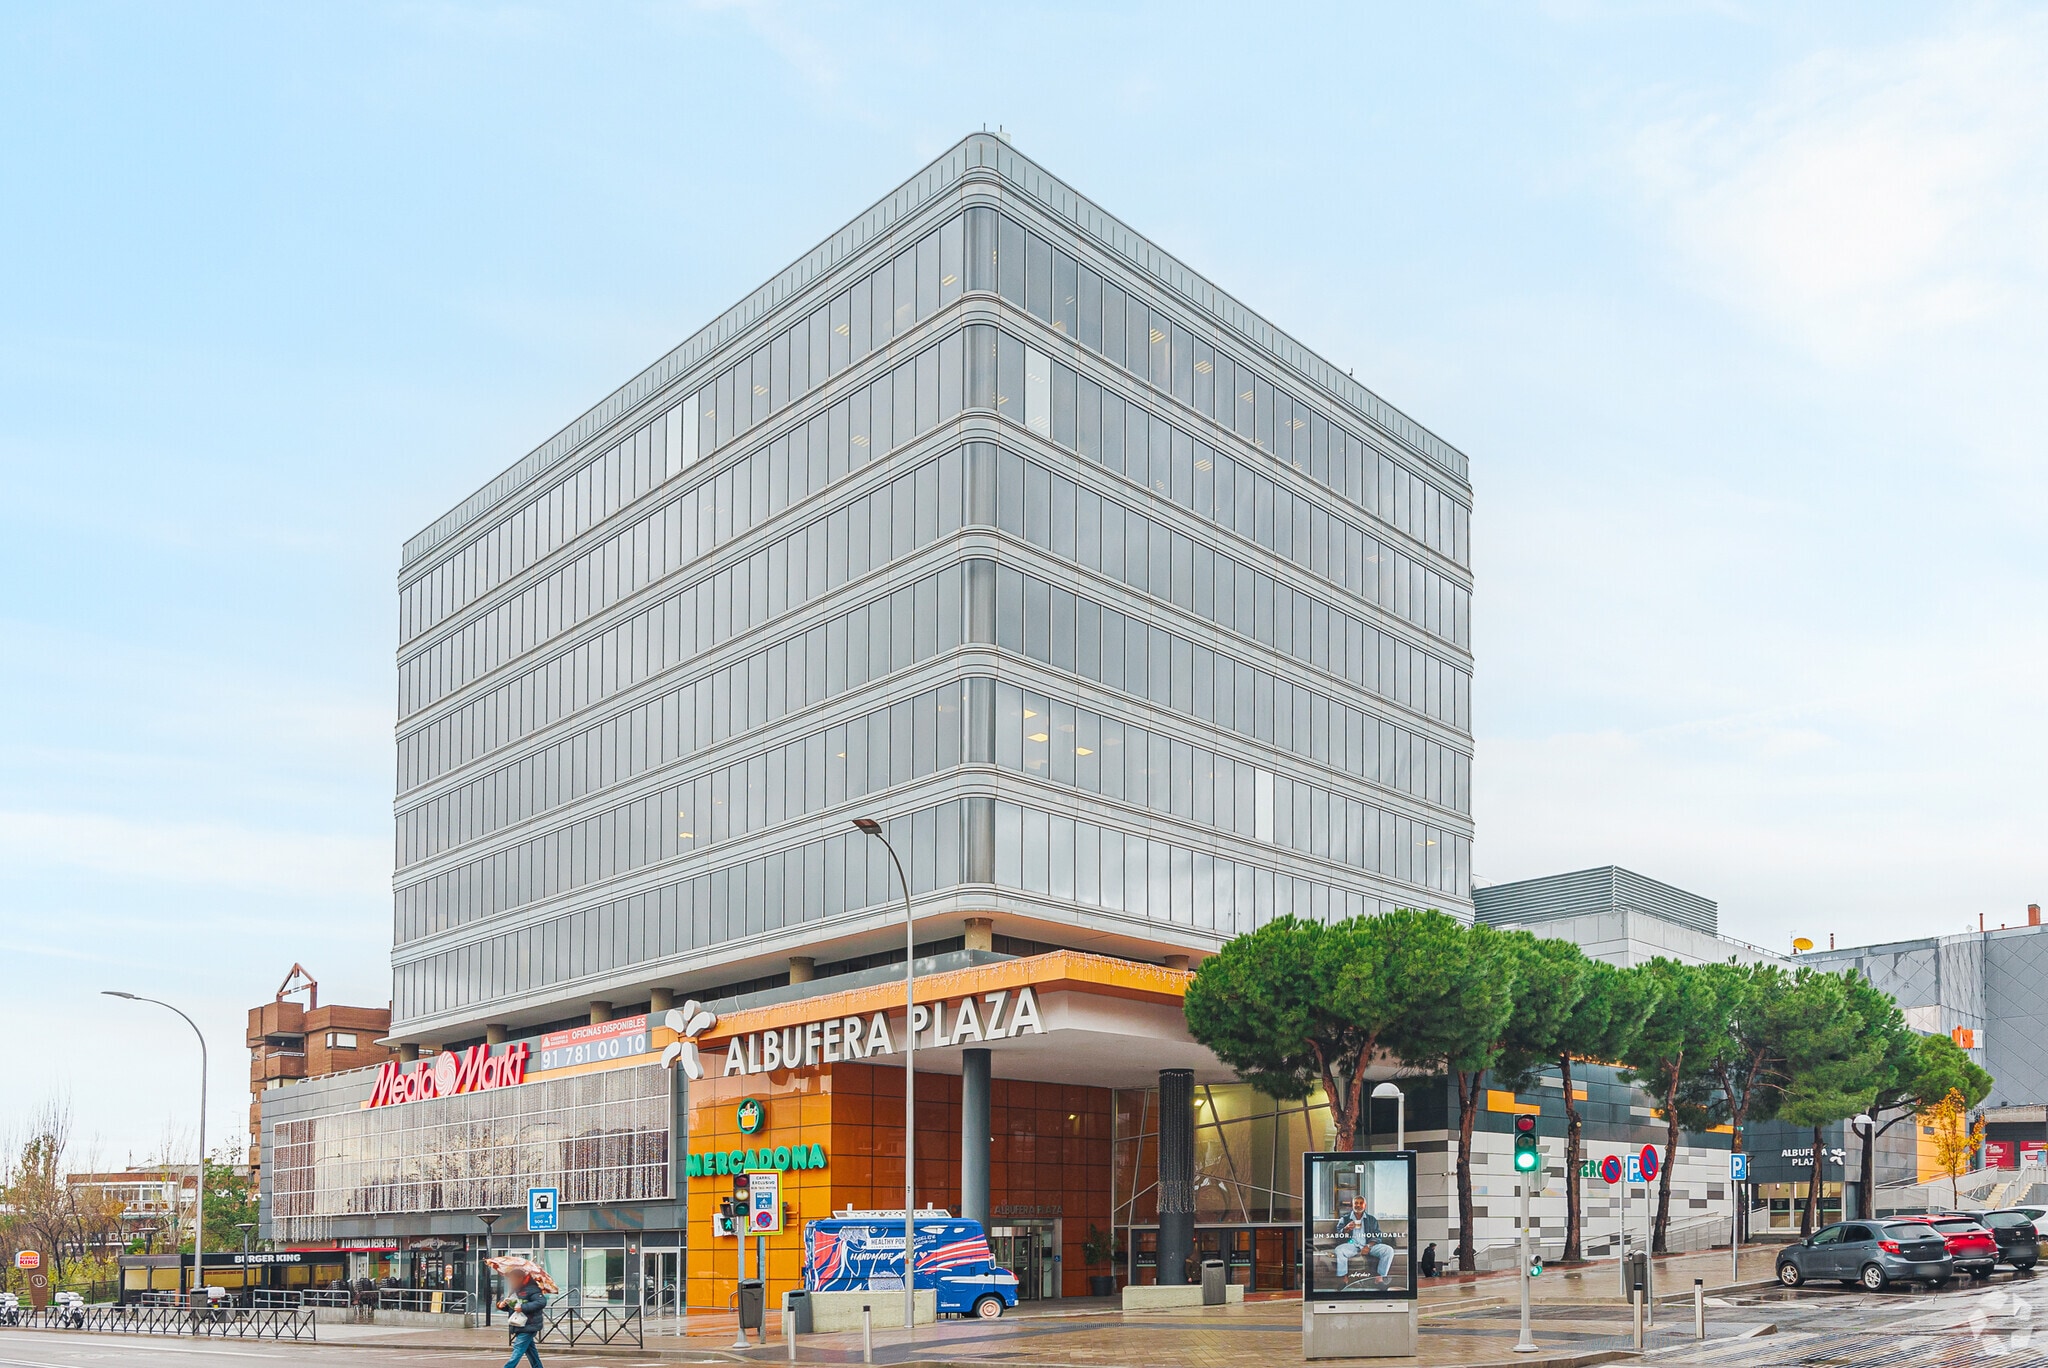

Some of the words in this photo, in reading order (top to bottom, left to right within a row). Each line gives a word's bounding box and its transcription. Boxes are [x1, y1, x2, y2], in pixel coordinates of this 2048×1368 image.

[571, 1026, 601, 1040] OFICINAS
[602, 1018, 646, 1034] DISPONIBLES
[723, 1011, 898, 1077] ALBUFERA
[912, 986, 1048, 1050] PLAZA
[543, 1050, 558, 1069] 91
[565, 1044, 591, 1065] 781
[597, 1039, 619, 1060] 00
[626, 1034, 645, 1055] 10
[368, 1061, 438, 1108] Media
[450, 1042, 531, 1095] Markt
[1781, 1148, 1828, 1157] ALBUFEA
[686, 1143, 827, 1178] MERCADONA
[1792, 1157, 1814, 1166] PLAZ
[994, 1205, 1035, 1214] ALBUFERA
[1037, 1205, 1063, 1214] PLAZA
[276, 1254, 301, 1262] KING
[850, 1252, 894, 1261] HANDMADE
